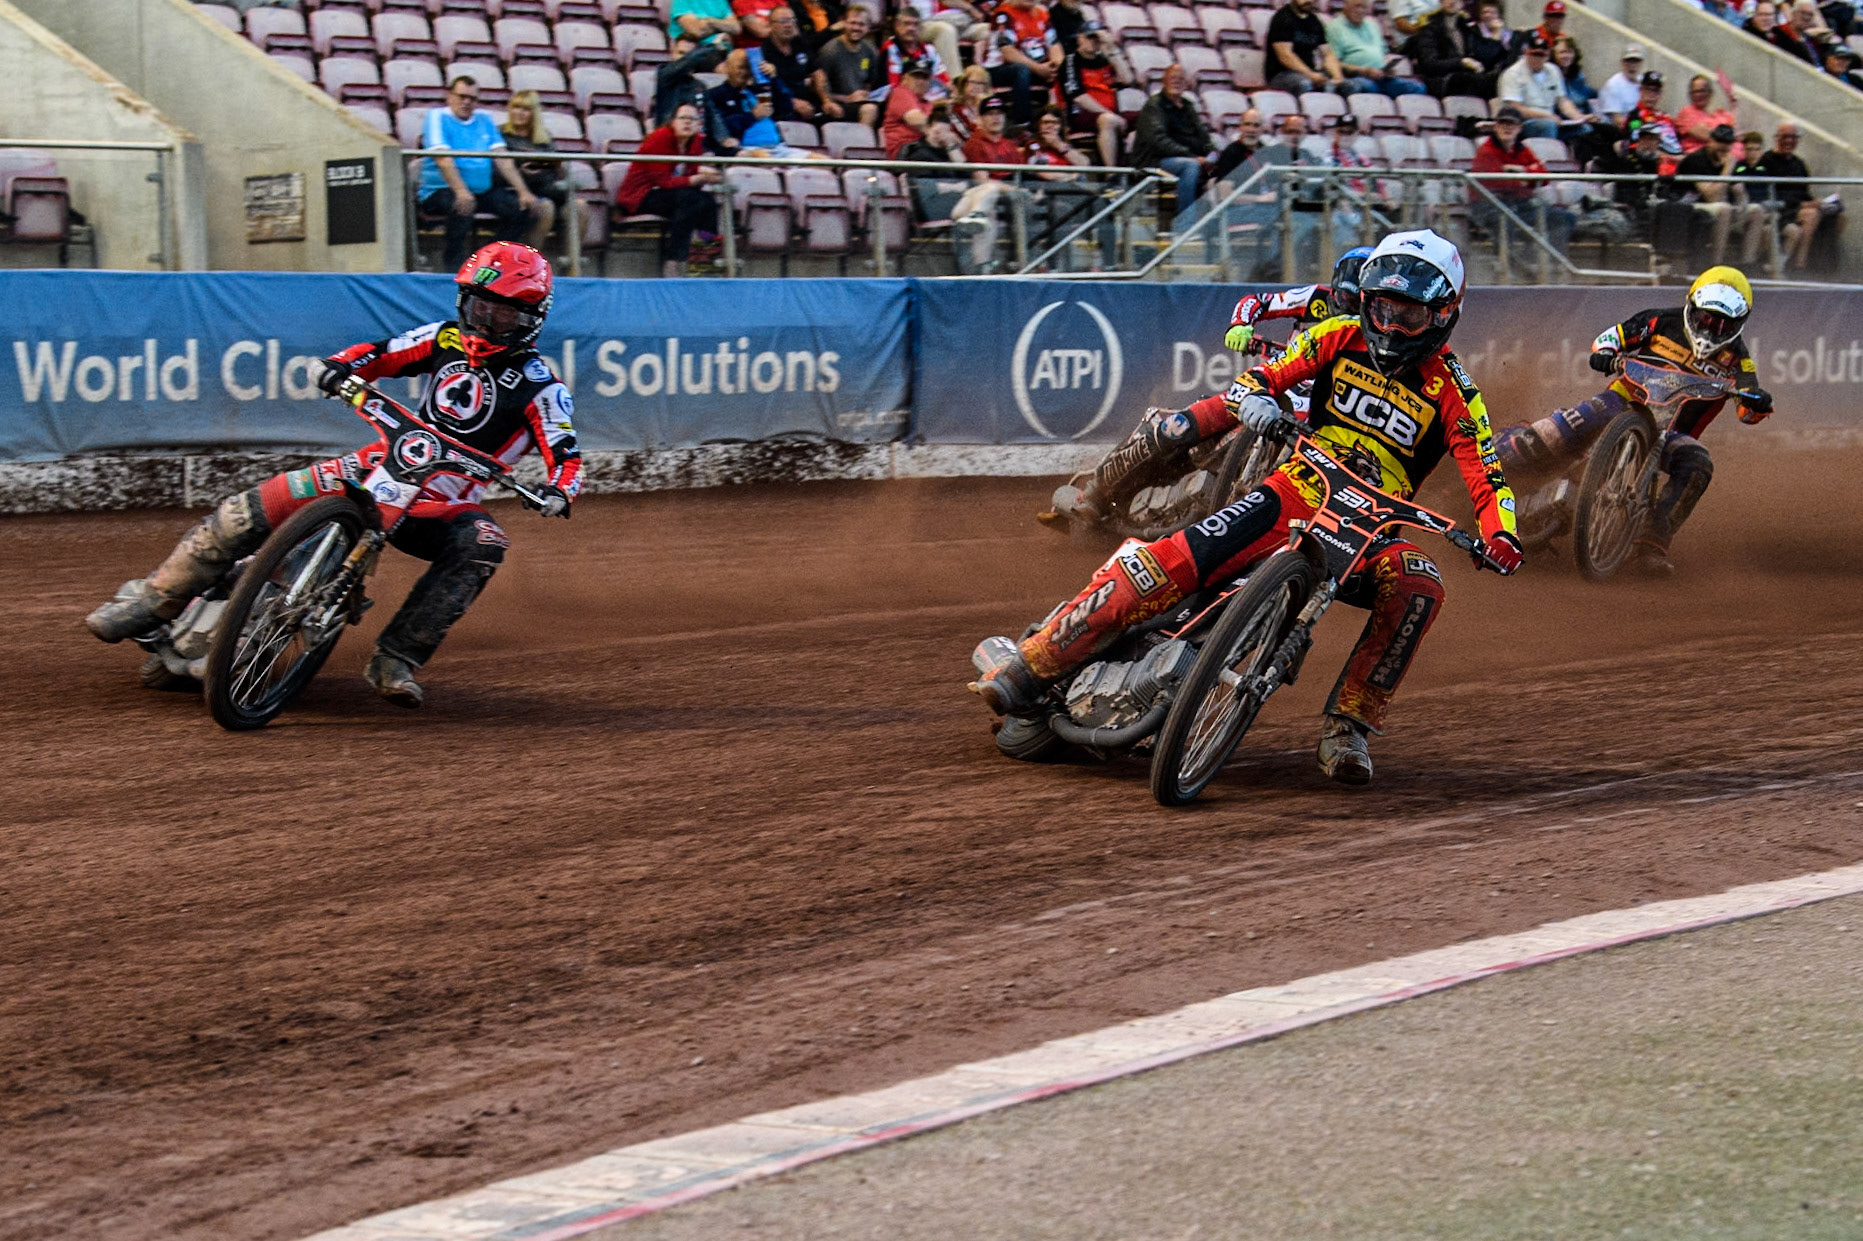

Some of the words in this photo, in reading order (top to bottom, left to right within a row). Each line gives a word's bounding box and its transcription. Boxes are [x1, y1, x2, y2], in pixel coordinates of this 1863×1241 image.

[13, 339, 198, 402] World
[221, 339, 320, 401] Cla
[595, 337, 841, 397] Solutions
[1029, 349, 1103, 390] ATPI
[1343, 363, 1401, 396] WATLING
[1401, 394, 1423, 413] JCB
[1425, 375, 1445, 396] 3
[1333, 388, 1418, 447] JCB
[1306, 448, 1338, 470] JWP
[1409, 559, 1441, 582] JC
[1051, 580, 1116, 642] JWP
